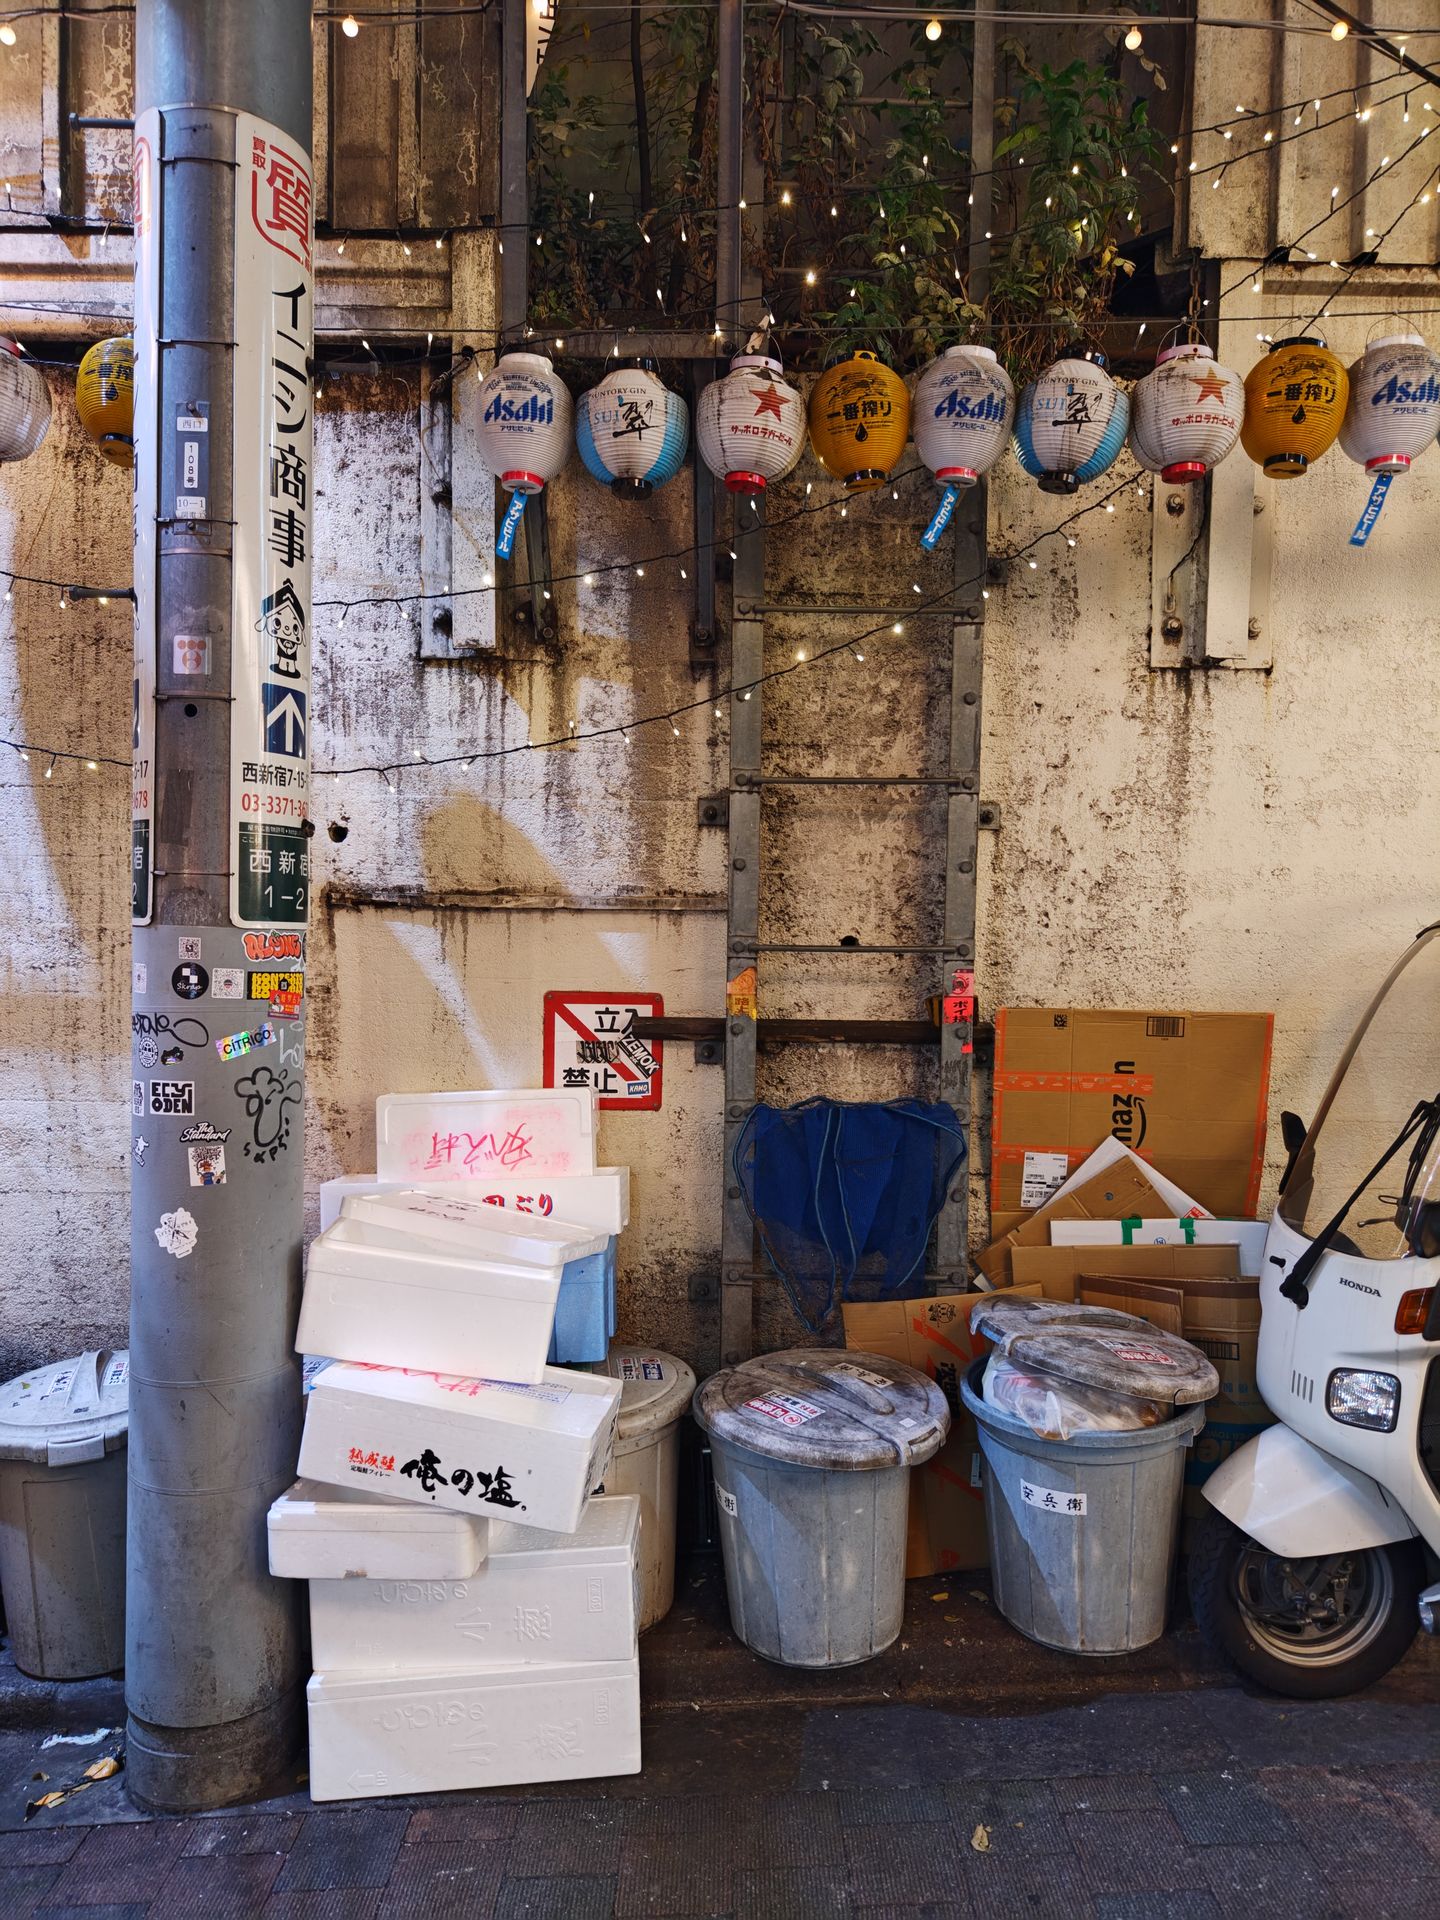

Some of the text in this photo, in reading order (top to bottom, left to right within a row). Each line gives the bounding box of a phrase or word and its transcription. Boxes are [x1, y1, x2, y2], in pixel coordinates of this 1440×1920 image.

[252, 136, 266, 171] 買取
[266, 159, 311, 257] 質
[629, 387, 647, 395] GIN
[1082, 377, 1099, 387] GIN
[1266, 383, 1336, 404] 一番搾り
[484, 393, 554, 425] Asahi
[827, 400, 892, 422] 一番搾り
[934, 388, 1006, 423] Asahi
[731, 424, 793, 447] サッポロラガービール
[186, 445, 196, 486] 108号
[498, 500, 523, 552] アサヒビール
[924, 492, 955, 543] アサヒビール
[1353, 485, 1387, 540] アサヒビール
[563, 1066, 618, 1093] 禁止
[1111, 1060, 1136, 1149] mazn
[180, 1128, 230, 1142] Standard
[196, 1121, 215, 1133] The
[1339, 1277, 1382, 1298] HONDA
[1022, 1485, 1083, 1512] 安兵衛
